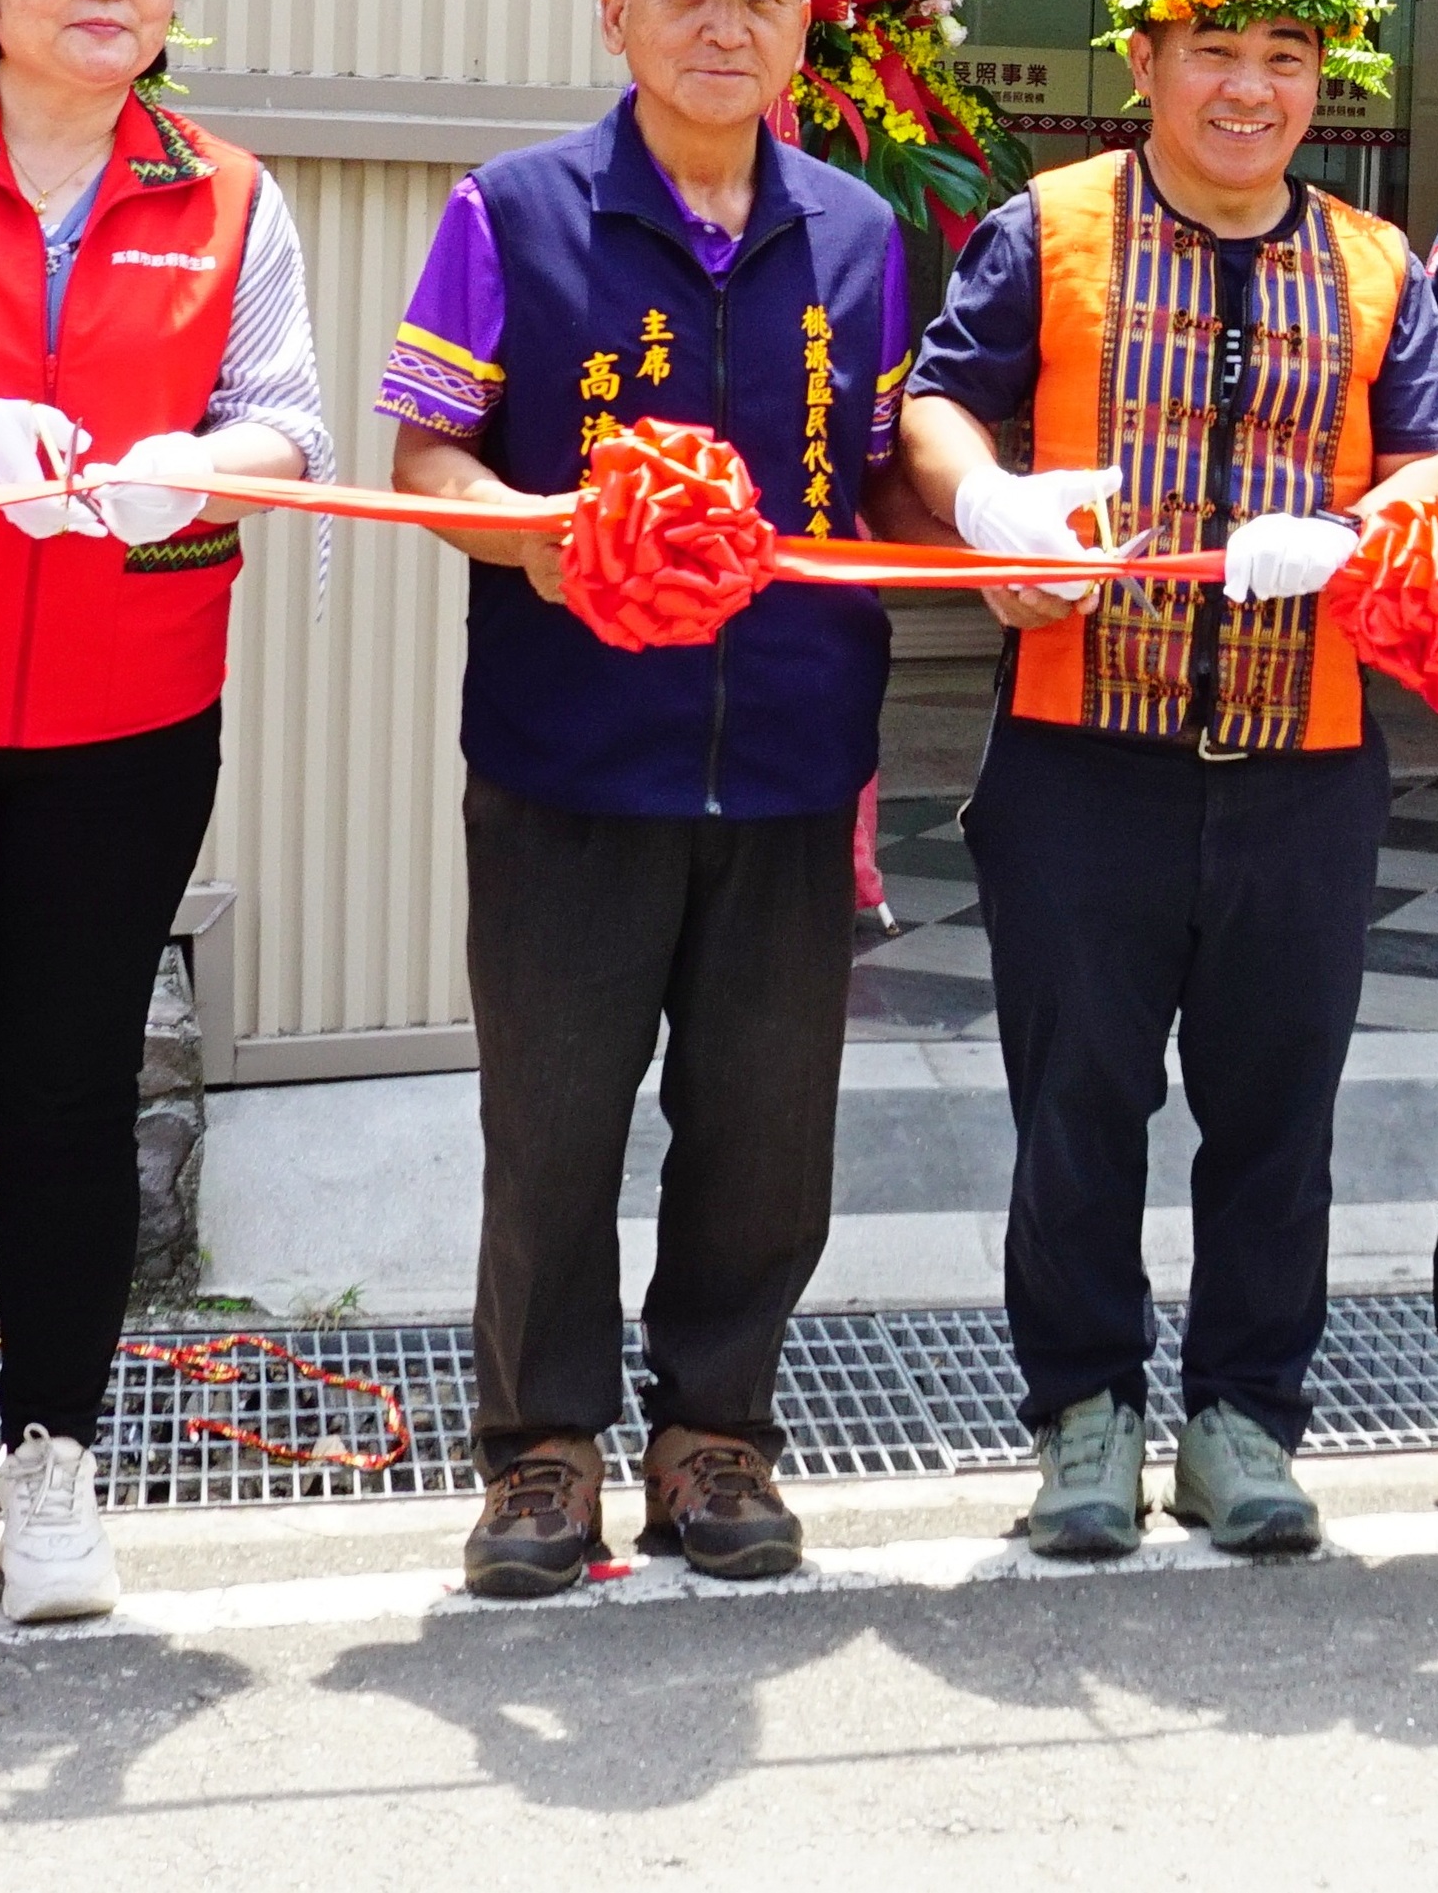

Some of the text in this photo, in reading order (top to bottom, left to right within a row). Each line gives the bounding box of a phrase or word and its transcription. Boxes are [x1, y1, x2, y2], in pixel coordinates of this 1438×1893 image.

[635, 308, 675, 387] 主席
[579, 351, 628, 490] 高清
[801, 304, 834, 542] 桃源區民代表會
